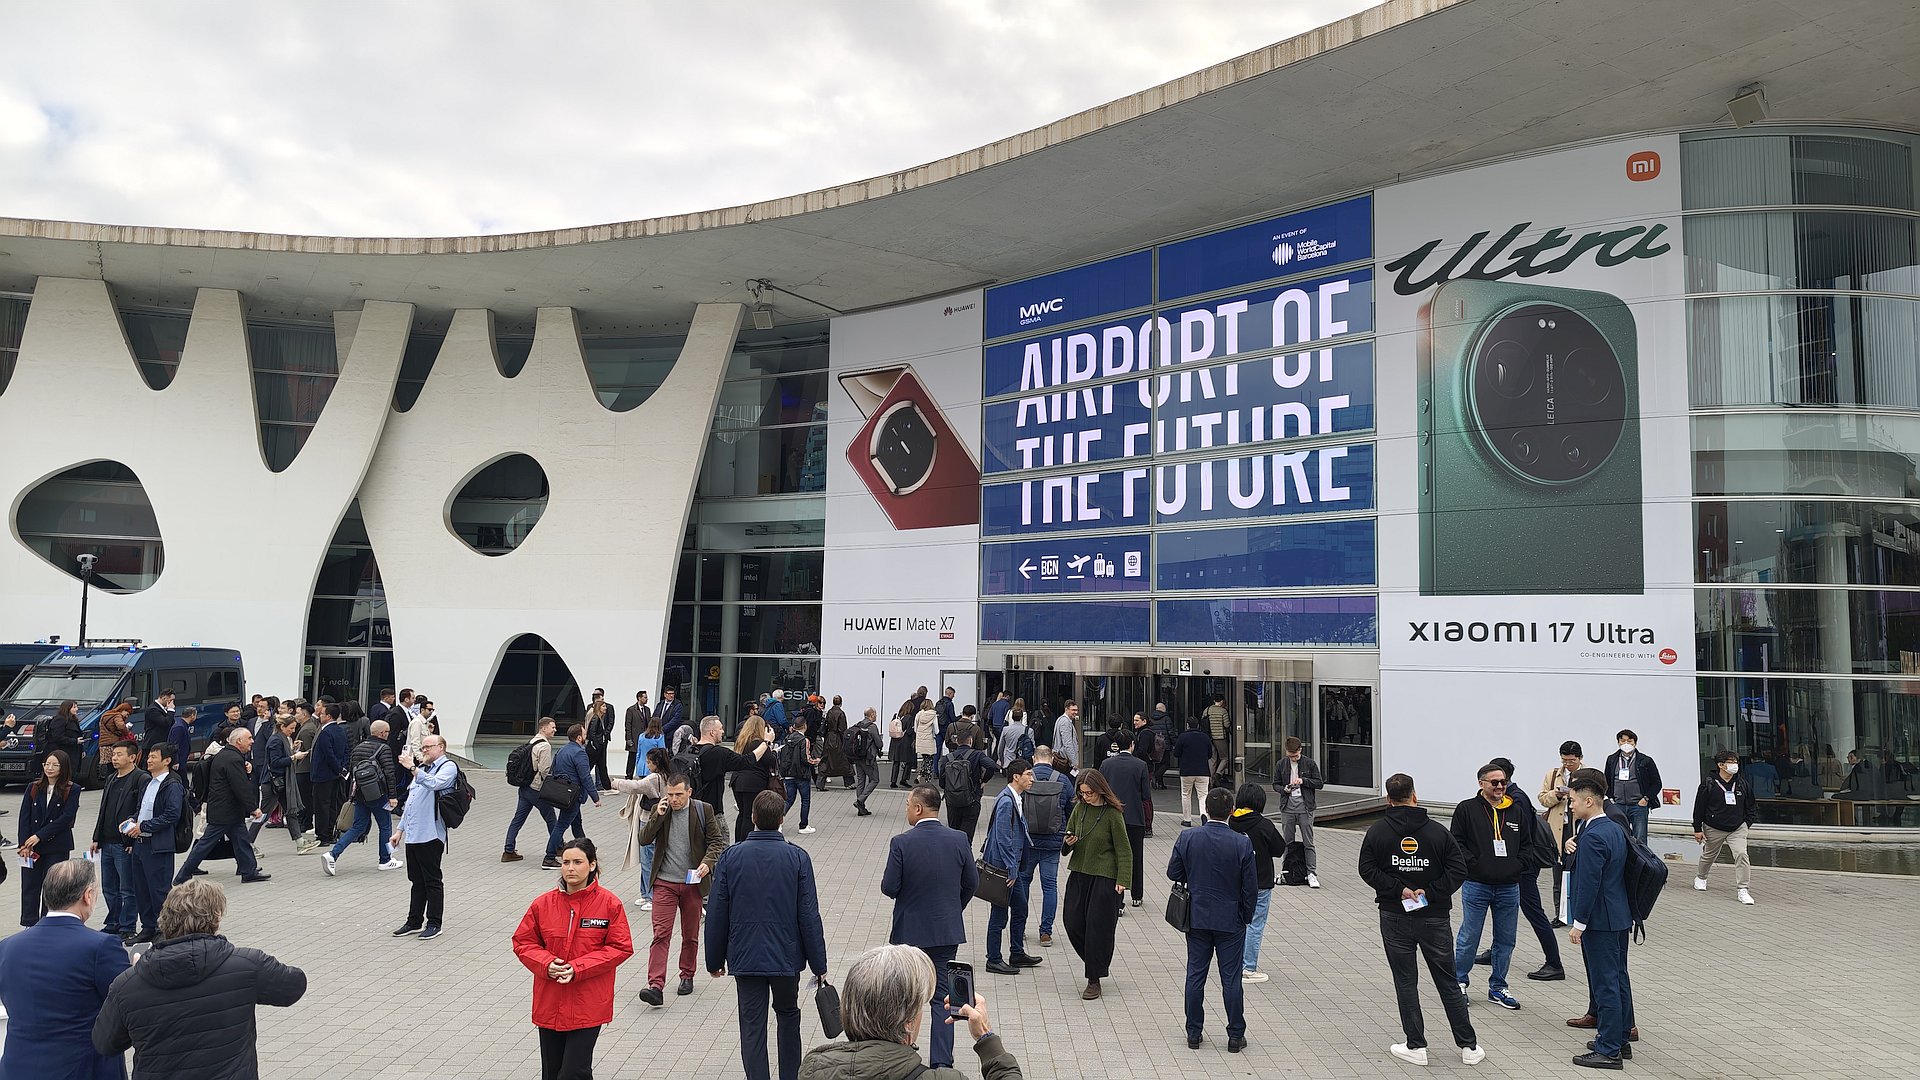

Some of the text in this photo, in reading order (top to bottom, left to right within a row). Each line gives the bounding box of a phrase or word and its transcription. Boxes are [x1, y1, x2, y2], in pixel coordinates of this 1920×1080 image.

[1281, 230, 1299, 239] EVENT
[1299, 227, 1308, 235] OF
[1297, 239, 1318, 249] Mobile
[1297, 240, 1337, 255] WorldCapital
[1297, 250, 1328, 261] Barcelona
[1384, 222, 1671, 295] Ultra
[953, 303, 976, 313] HUAWEI
[1020, 298, 1064, 319] MWC
[1020, 316, 1042, 326] GSMA
[1016, 279, 1350, 427] AIRPORT OF
[1546, 397, 1555, 425] LEICA
[1016, 394, 1350, 525] THE FUTURE
[1041, 560, 1059, 575] BCN
[844, 616, 955, 631] HUAWEI Mate X7
[1548, 622, 1575, 643] 17
[1587, 622, 1655, 645] Ultra
[857, 645, 941, 656] Unfold the Moment
[1580, 651, 1635, 659] CO-ENGINEERED
[1391, 855, 1430, 867] Beeline
